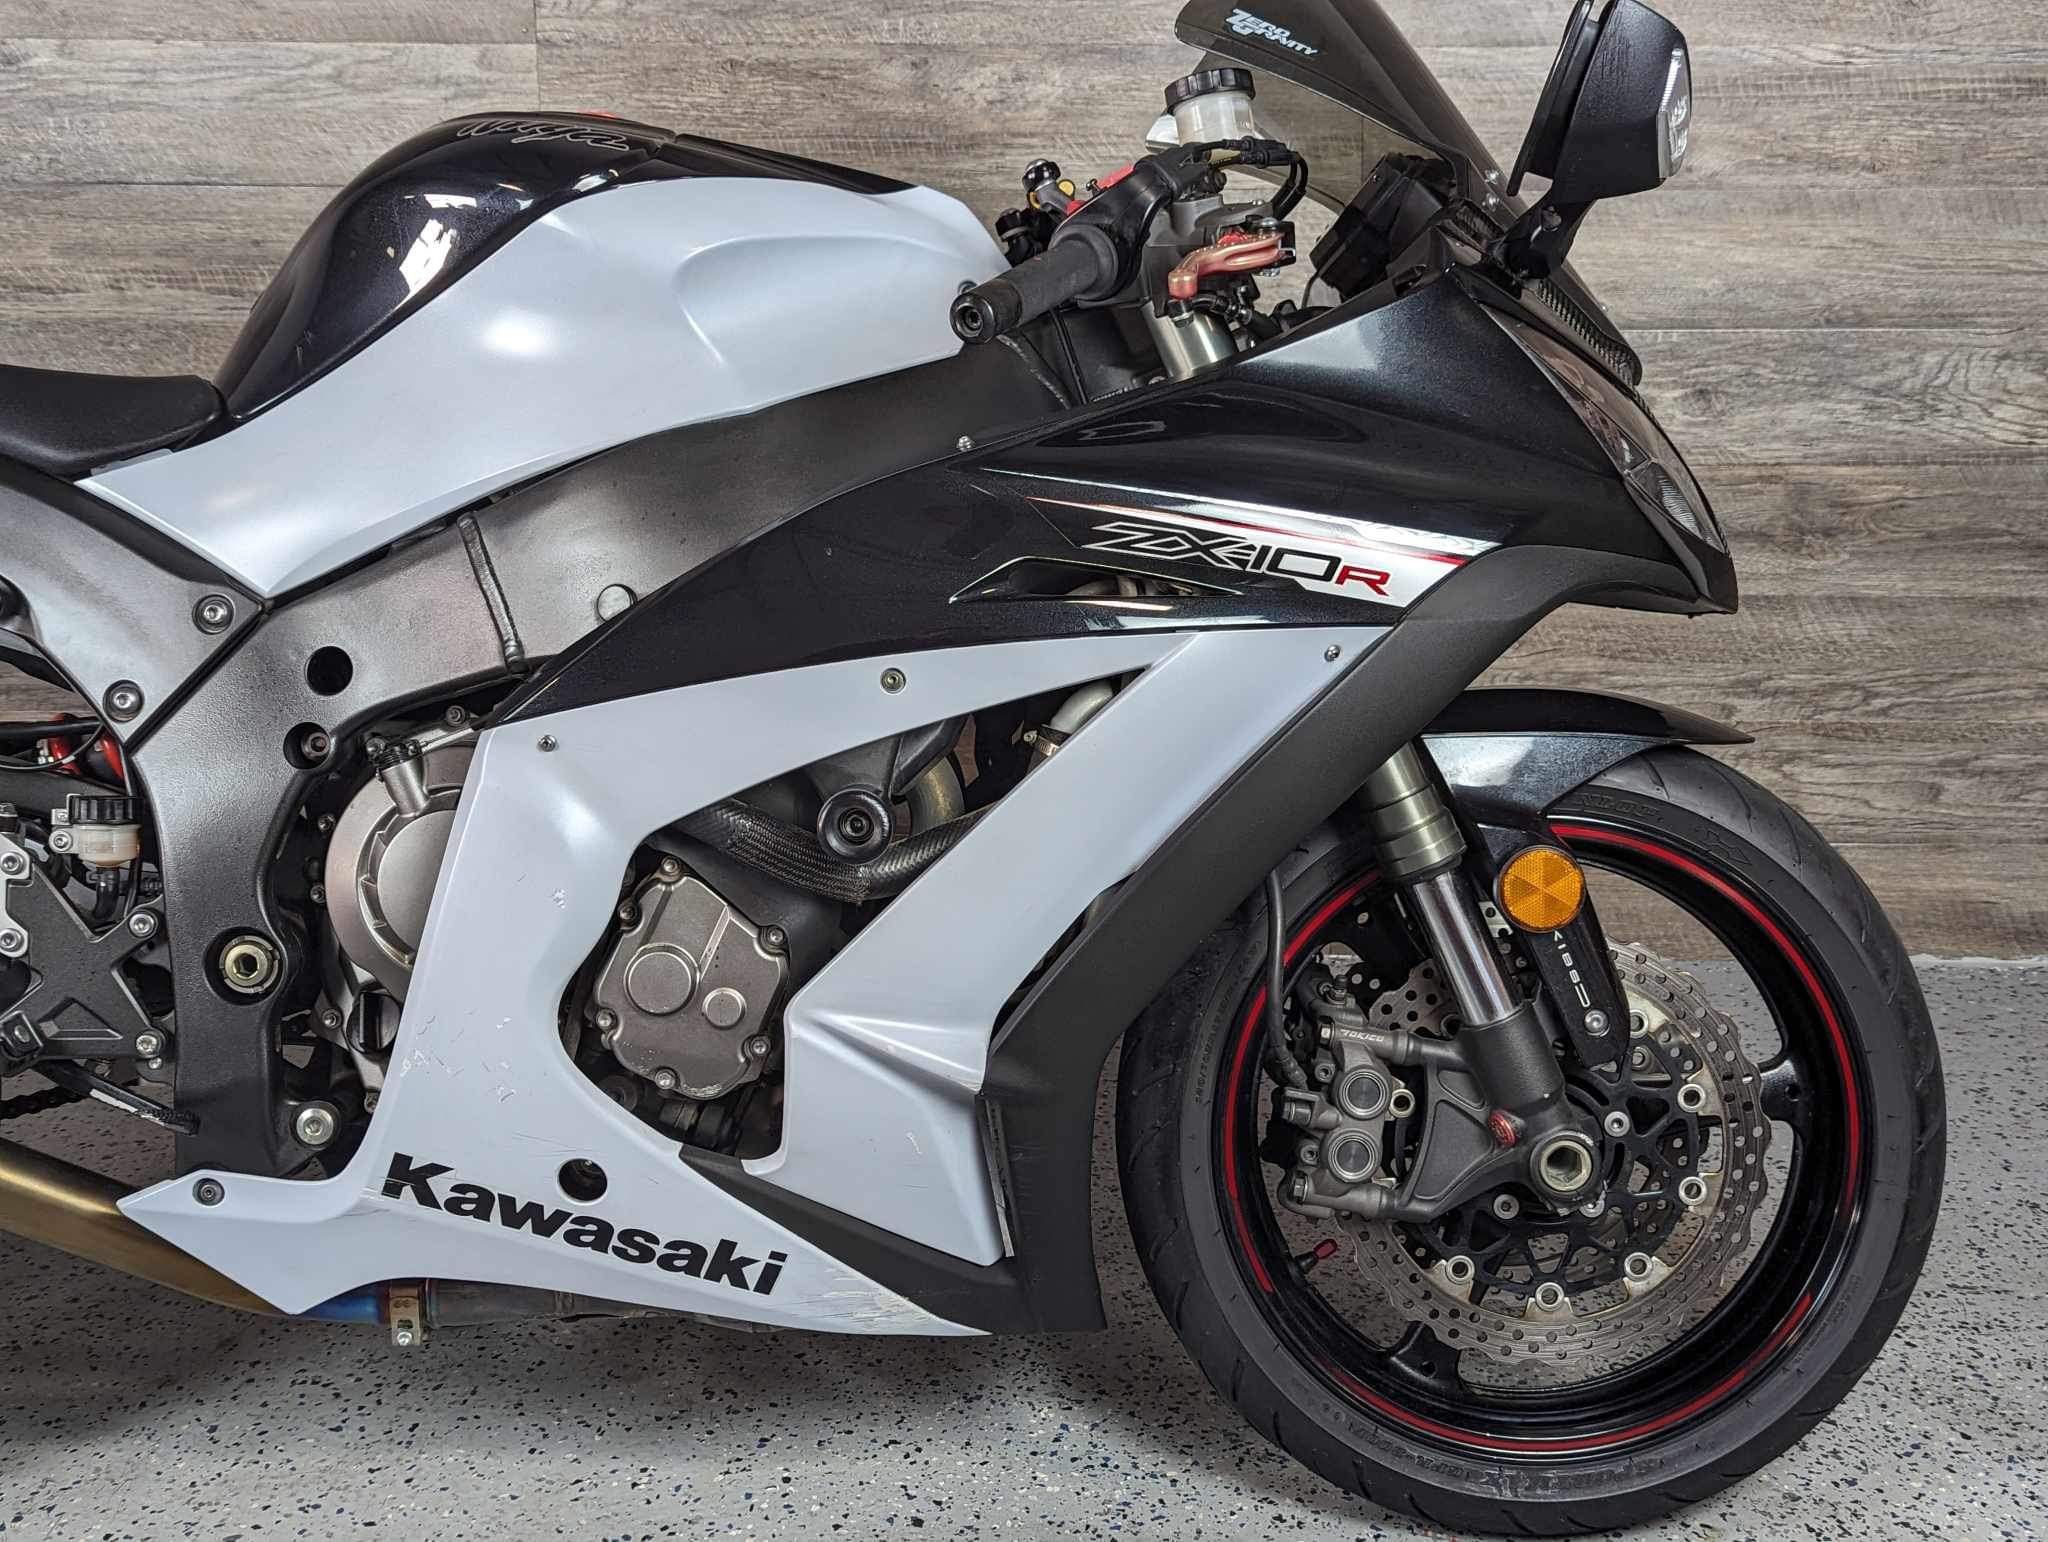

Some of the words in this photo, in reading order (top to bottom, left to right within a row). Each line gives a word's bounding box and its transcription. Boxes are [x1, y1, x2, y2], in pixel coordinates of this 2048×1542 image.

[1225, 8, 1291, 38] ZERO
[1231, 22, 1319, 55] GRAVITY
[1340, 1028, 1385, 1042] TOKICO
[381, 1152, 788, 1296] Kawasaki
